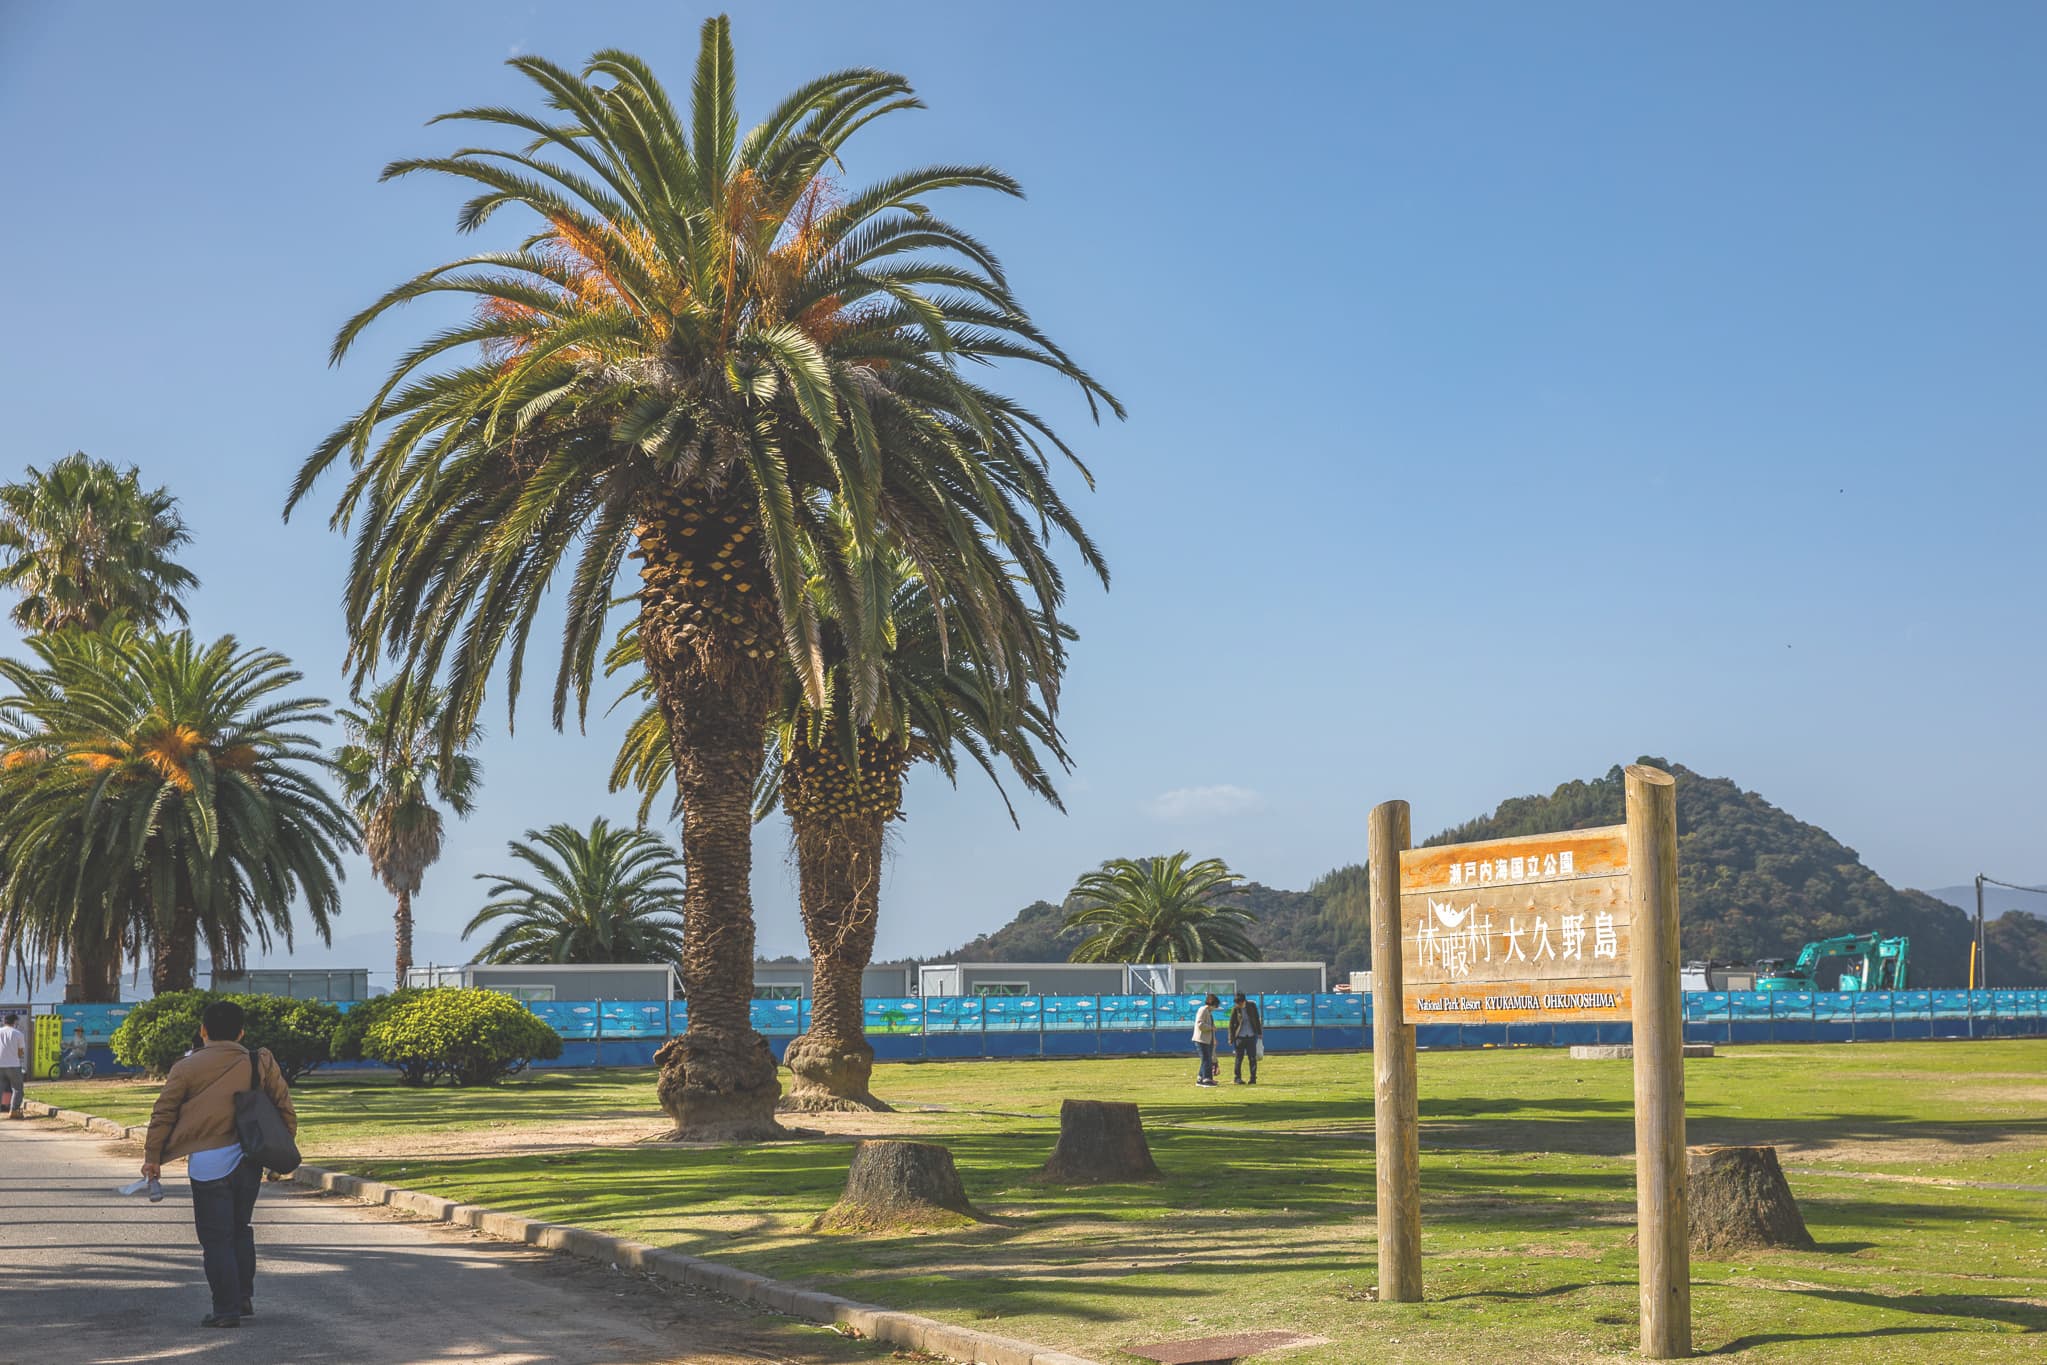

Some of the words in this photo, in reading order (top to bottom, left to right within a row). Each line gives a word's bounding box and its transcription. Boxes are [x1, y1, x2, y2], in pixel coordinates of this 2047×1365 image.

[1449, 851, 1574, 885] 瀬戸内海国立公園
[1417, 998, 1443, 1011] National
[1444, 998, 1460, 1011] Park
[1461, 997, 1482, 1011] Resort
[1485, 995, 1541, 1011] KYUKAMURA
[1543, 993, 1617, 1009] OHKUNOSHIMA
